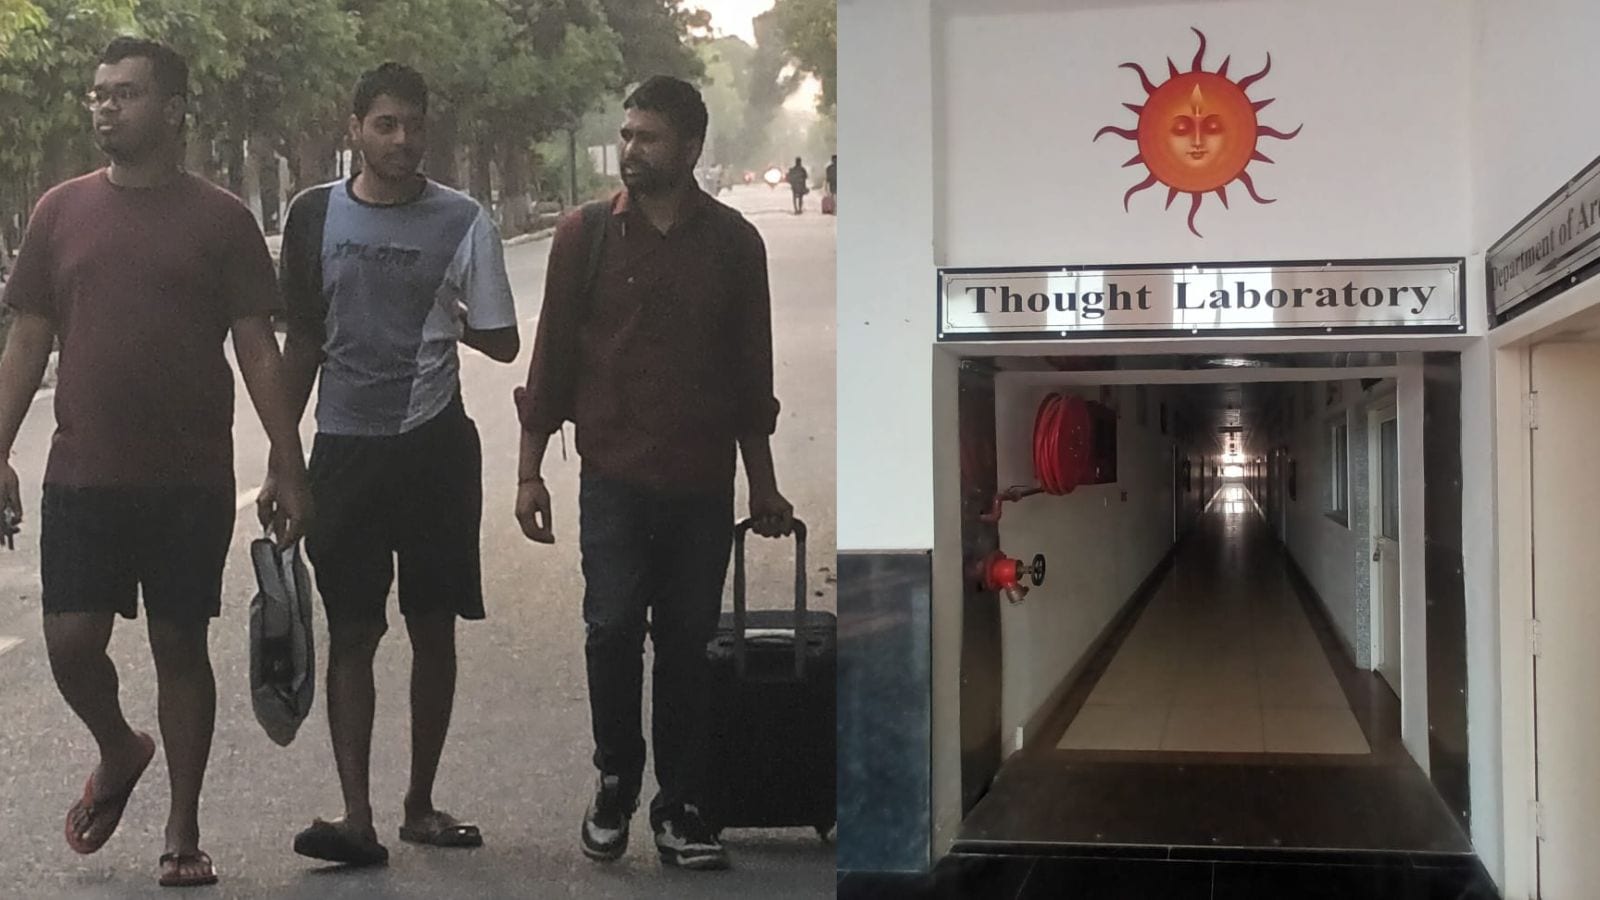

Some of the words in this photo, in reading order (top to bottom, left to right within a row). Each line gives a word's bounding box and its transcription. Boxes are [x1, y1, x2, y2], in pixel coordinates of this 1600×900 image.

[1492, 227, 1555, 292] Department
[1558, 207, 1574, 244] of
[1576, 200, 1600, 235] Ar
[965, 284, 1152, 319] Thought
[1173, 281, 1436, 314] Laboratory
